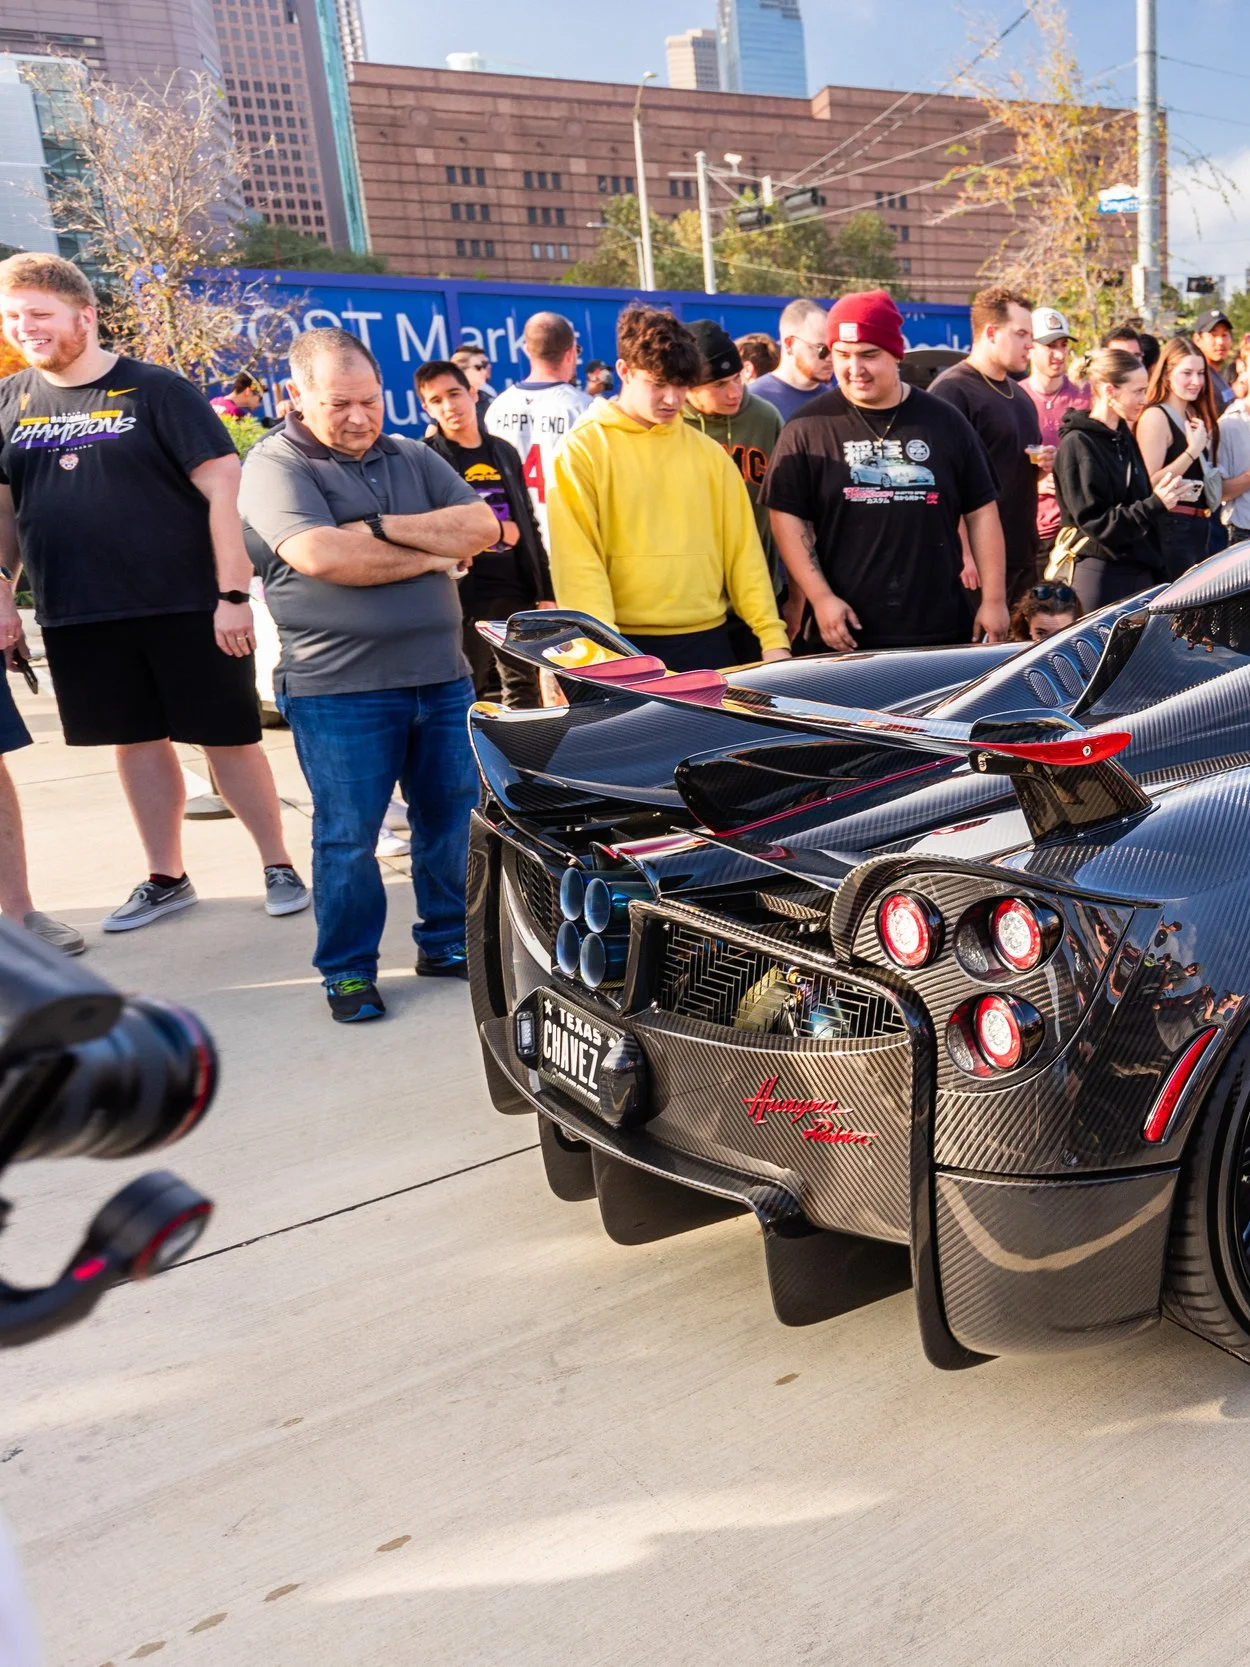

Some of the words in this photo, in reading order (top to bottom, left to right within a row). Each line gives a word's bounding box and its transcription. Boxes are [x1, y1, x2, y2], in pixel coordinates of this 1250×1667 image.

[396, 312, 583, 365] Mark
[11, 411, 136, 449] CHAMPIONS
[558, 1007, 602, 1047] TEXAS
[542, 1019, 599, 1091] CHAVEZ
